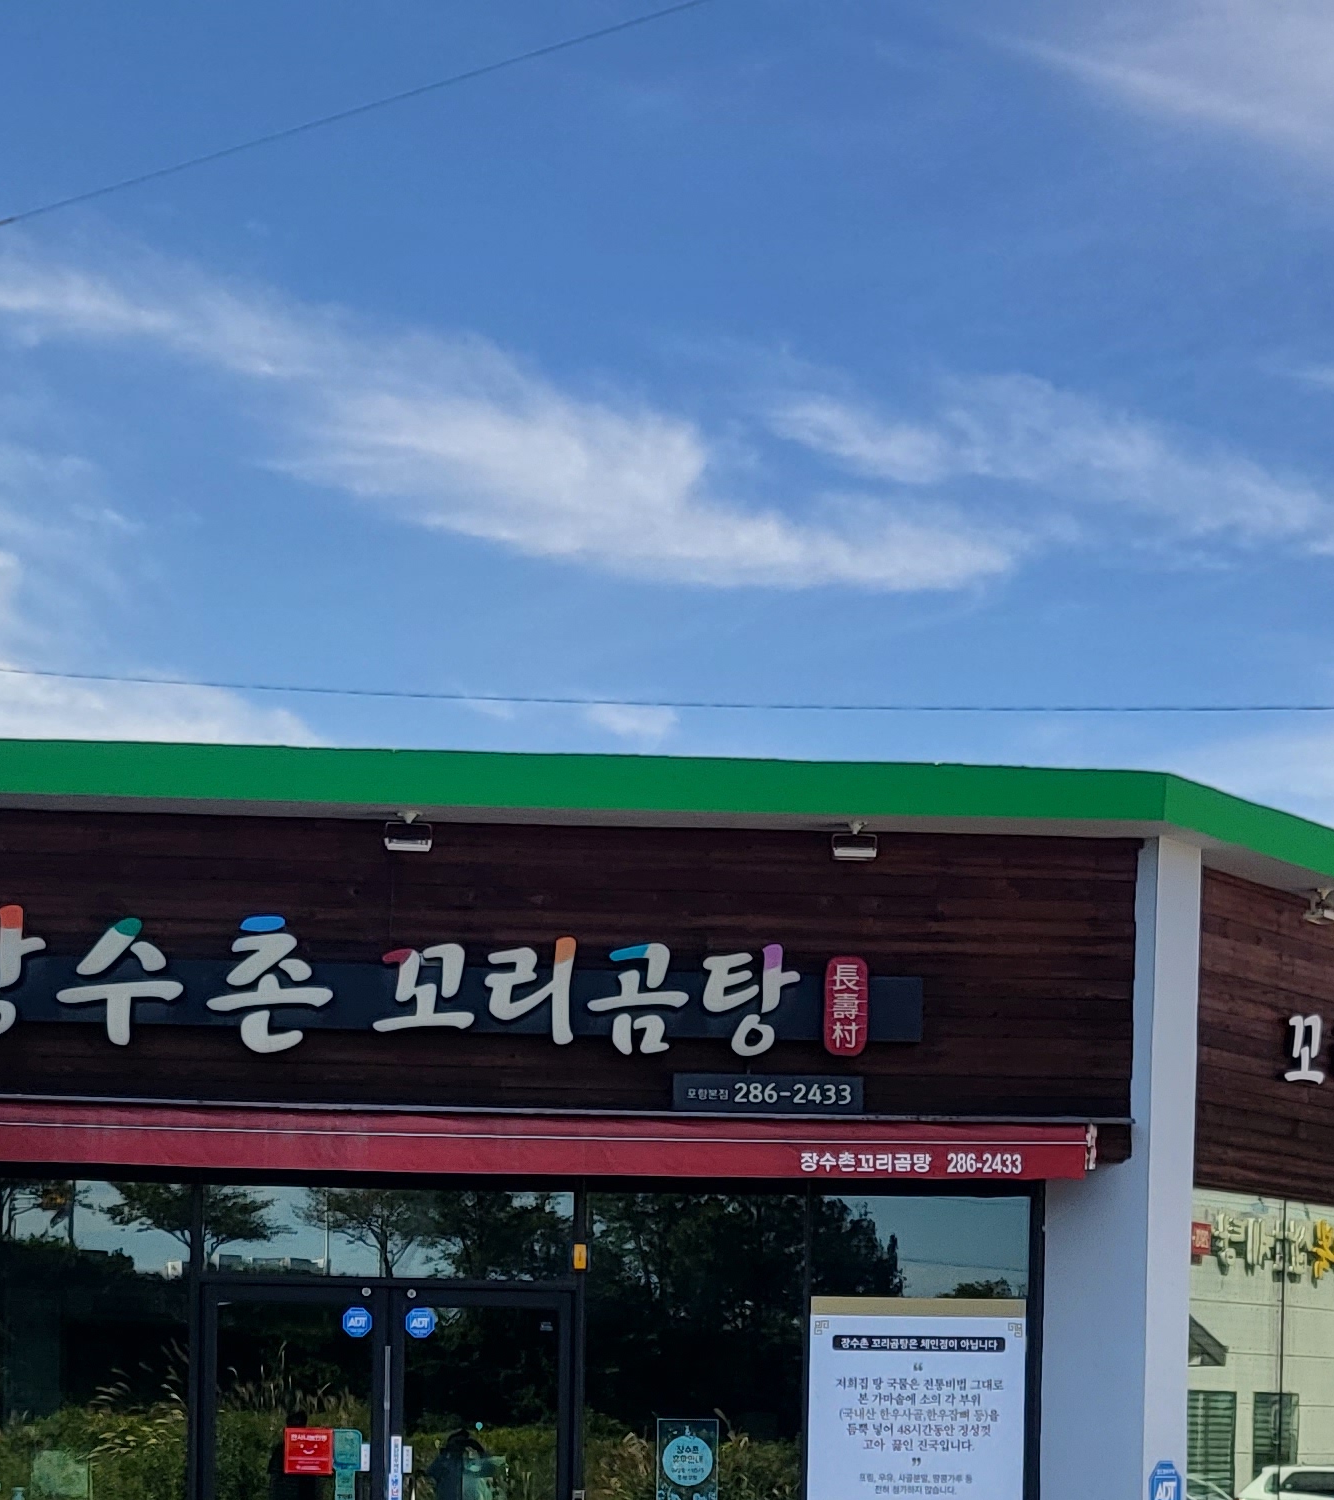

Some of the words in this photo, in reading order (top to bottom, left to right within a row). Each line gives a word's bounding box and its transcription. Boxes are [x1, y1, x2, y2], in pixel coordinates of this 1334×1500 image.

[372, 937, 800, 1056] 꼬리곰탕
[831, 963, 860, 1049] 長壽村
[733, 1082, 853, 1105] 286-2433
[800, 1151, 932, 1174] 장수촌꼬리곰탕
[946, 1153, 1023, 1175] 286-2433
[347, 1316, 367, 1328] ADT
[410, 1317, 430, 1329] ADT
[840, 1337, 869, 1350] 장수촌
[871, 1337, 918, 1351] 꼬리곰탕은
[919, 1338, 958, 1351] 체인점이
[960, 1338, 998, 1352] 아닙니다
[835, 1377, 869, 1390] 저희집
[887, 1378, 919, 1391] 국물은
[923, 1378, 968, 1391] 전통비법
[970, 1378, 1005, 1392] 그대로
[871, 1393, 916, 1407] 가마솥에
[919, 1393, 942, 1407] 소의
[944, 1393, 956, 1407] 각
[959, 1393, 982, 1407] 부위
[872, 1423, 895, 1438] 넣어
[896, 1423, 955, 1437] 48시간동안
[958, 1423, 992, 1438] 정성껏
[862, 1439, 885, 1452] 고아
[891, 1439, 914, 1452] 끓인
